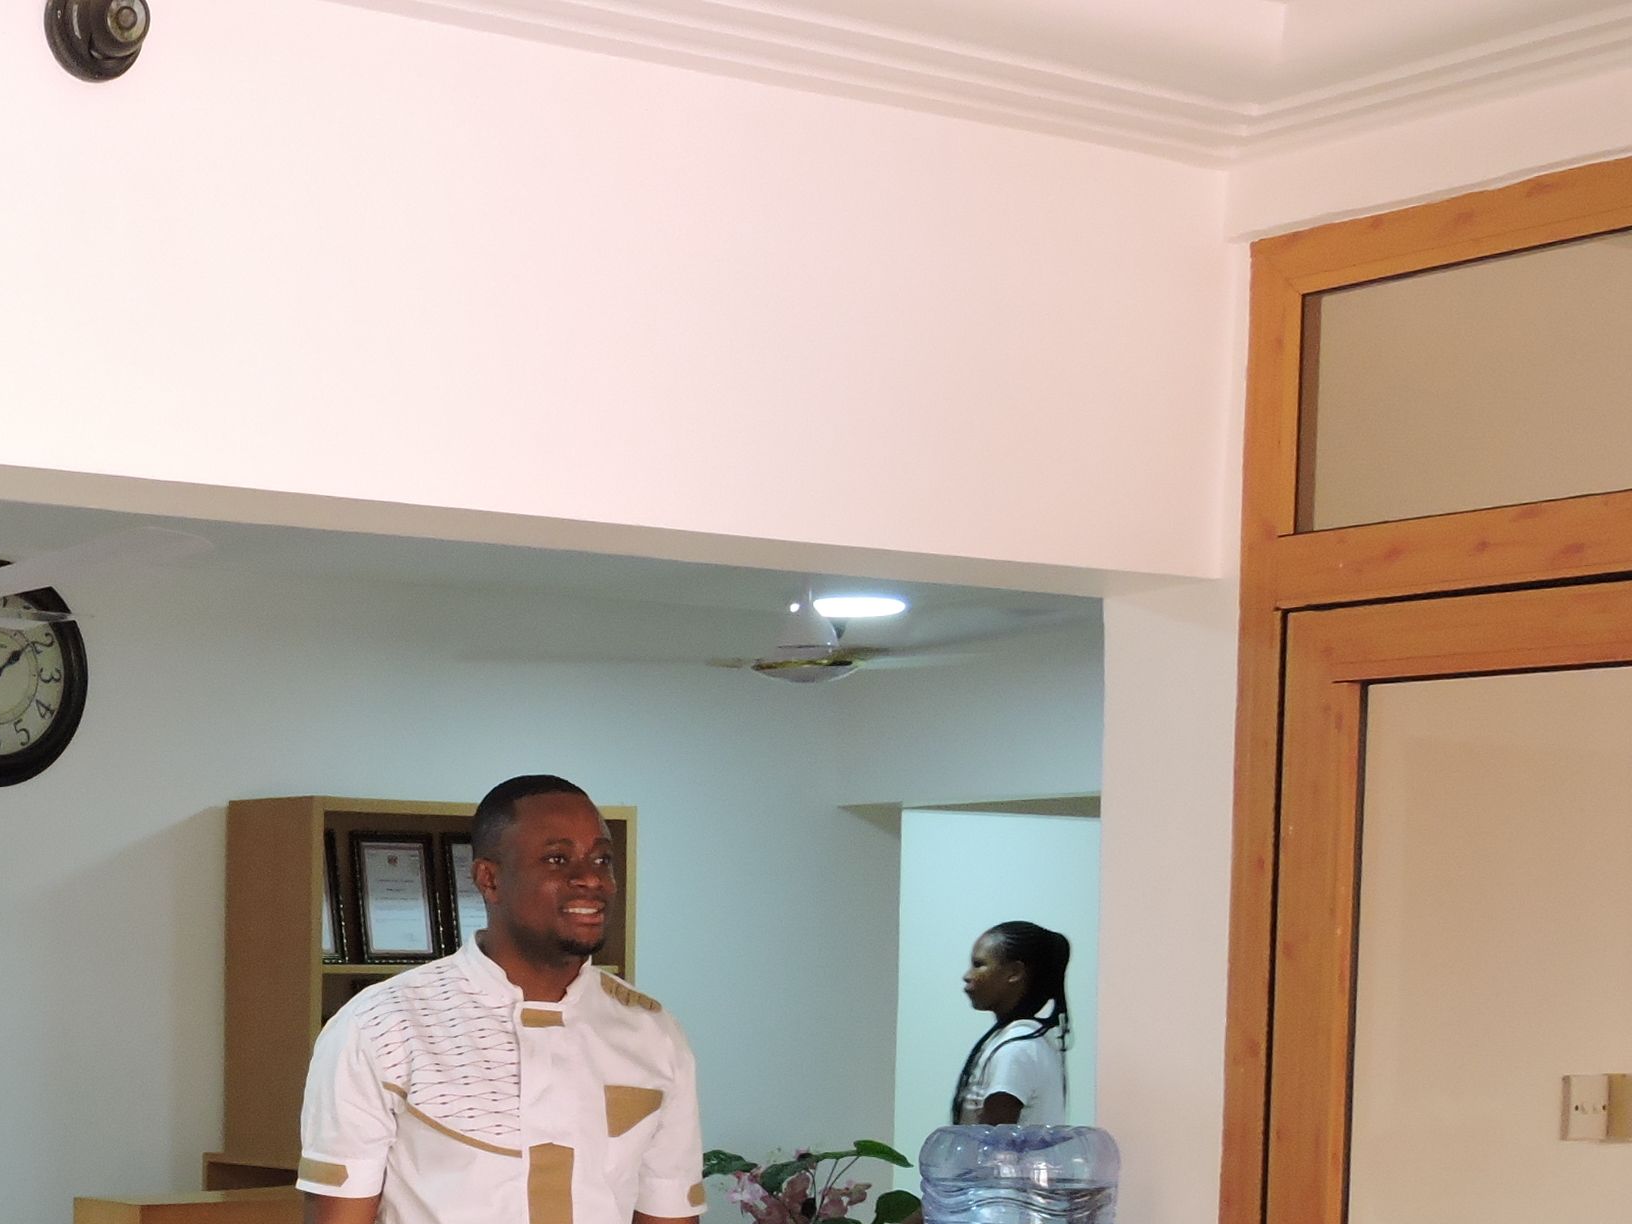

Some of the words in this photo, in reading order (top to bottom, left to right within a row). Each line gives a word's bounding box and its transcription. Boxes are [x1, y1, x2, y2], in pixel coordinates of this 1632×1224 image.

[30, 632, 55, 655] 2
[39, 667, 62, 684] 3
[35, 698, 57, 719] 4
[13, 718, 30, 746] 5
